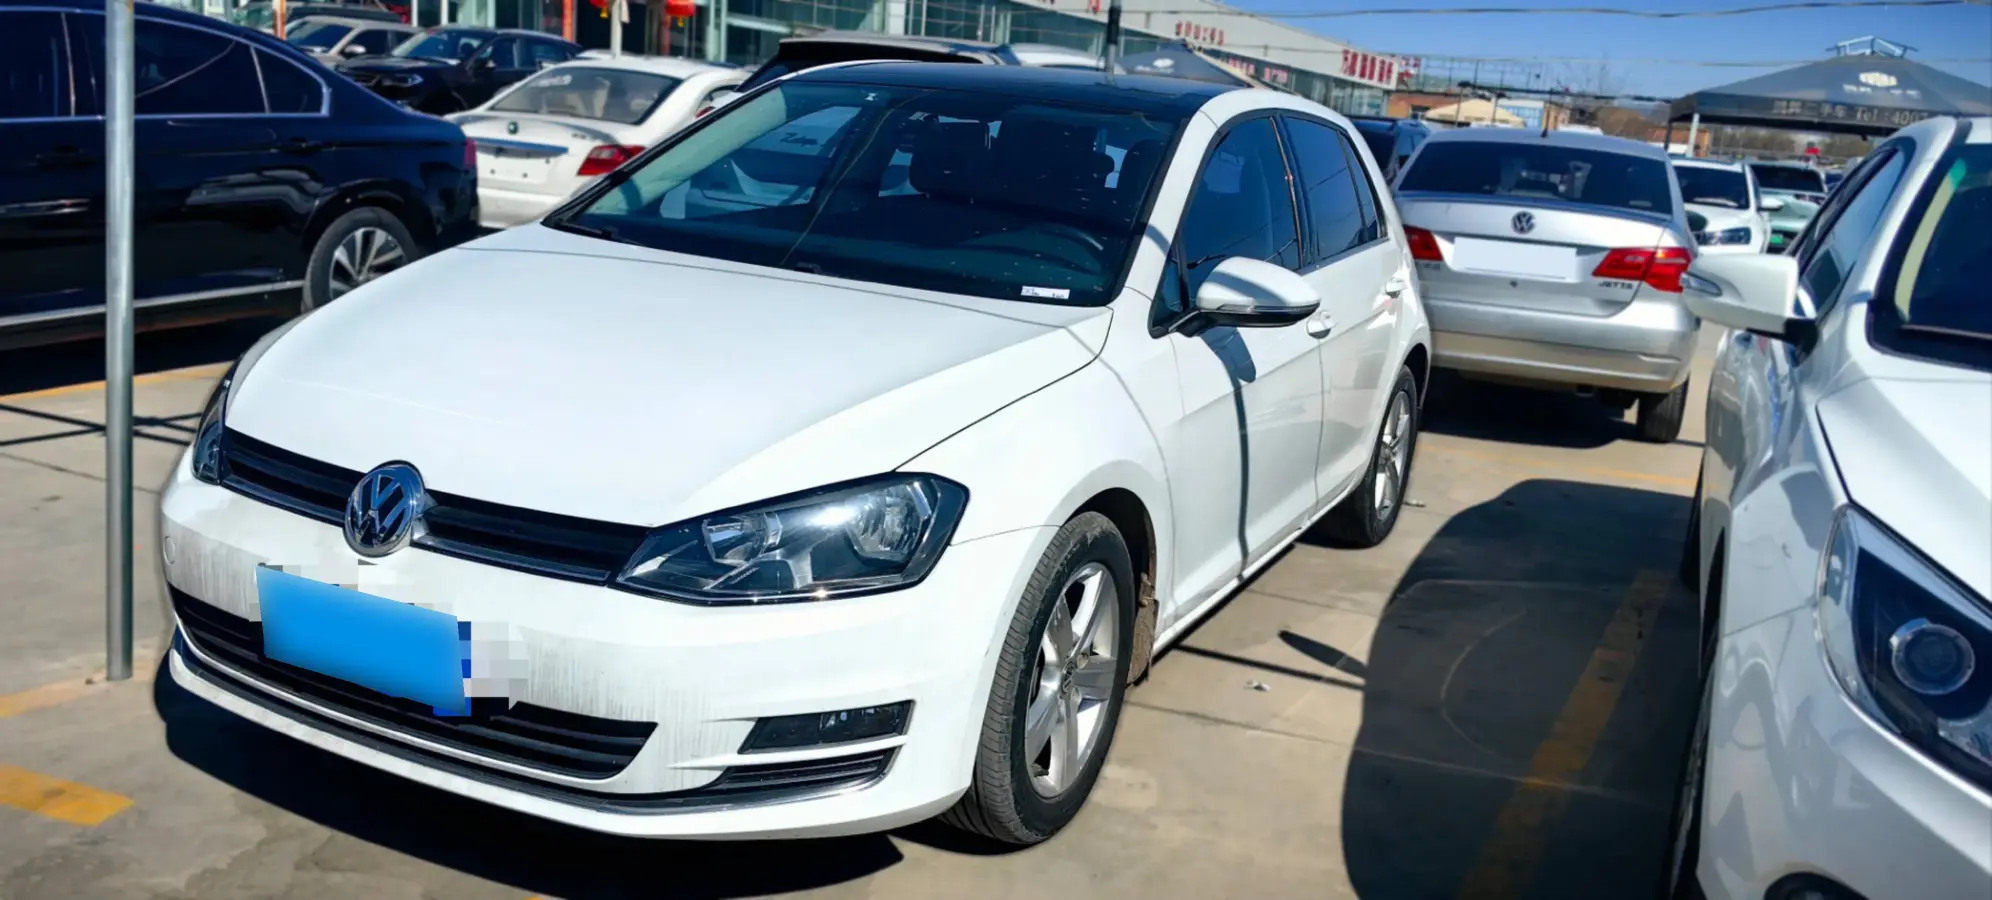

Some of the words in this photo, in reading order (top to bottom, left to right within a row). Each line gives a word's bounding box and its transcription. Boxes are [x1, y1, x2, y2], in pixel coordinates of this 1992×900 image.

[1854, 106, 1879, 121] Tel
[1597, 281, 1633, 290] JETTA
[350, 465, 418, 552] VW
